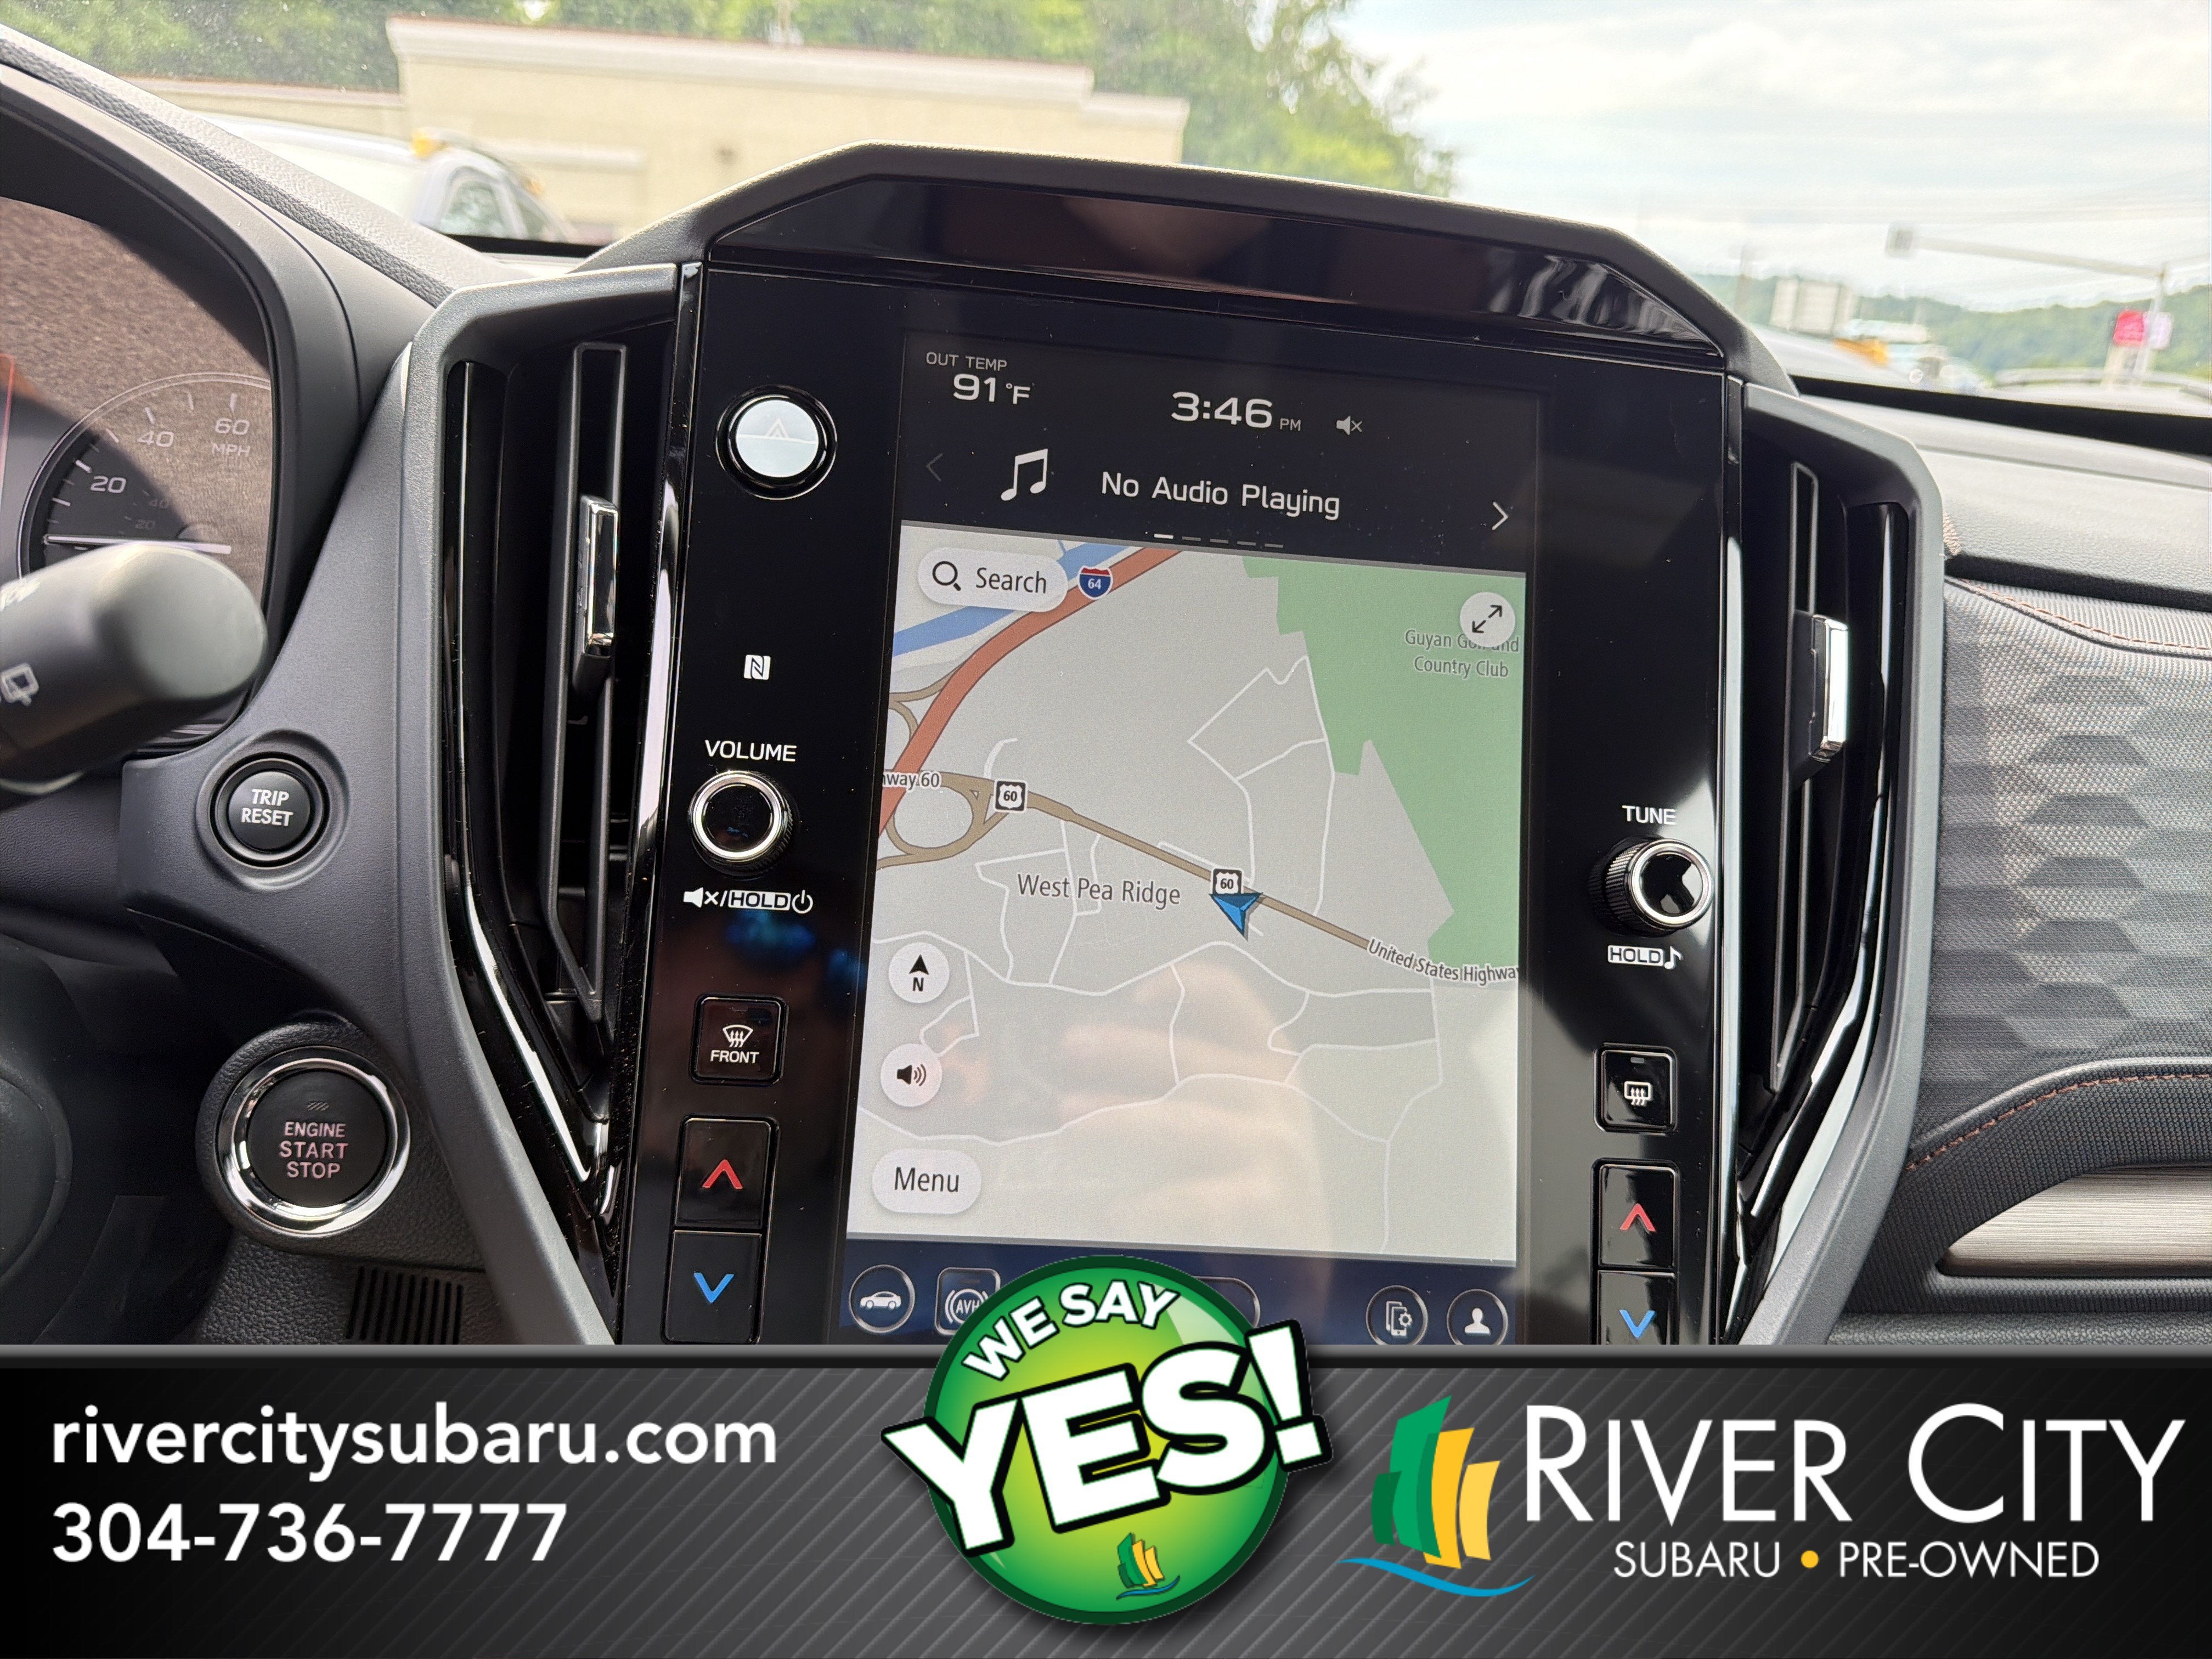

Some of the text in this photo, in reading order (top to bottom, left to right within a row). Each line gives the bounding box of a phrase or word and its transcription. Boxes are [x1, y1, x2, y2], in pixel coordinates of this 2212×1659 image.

[926, 352, 1007, 371] OUT TEMP
[953, 373, 996, 402] 91
[1171, 392, 1301, 431] 3:46 PM
[215, 418, 250, 435] 60
[138, 430, 174, 447] 40
[212, 442, 250, 456] MPH
[91, 476, 126, 494] 20
[1102, 471, 1340, 521] No Audio Playing
[975, 567, 1047, 594] Search
[1088, 579, 1102, 590] 64
[1405, 630, 1451, 650] Guyan
[1414, 656, 1508, 679] Country Club
[705, 740, 797, 762] VOLUME
[922, 772, 940, 788] 60
[251, 789, 289, 806] TRIP
[1003, 790, 1017, 802] 60
[241, 808, 294, 826] RESET
[1622, 805, 1676, 825] TUNE
[1018, 874, 1181, 910] West Pea Ridge
[1221, 878, 1234, 889] 60
[1369, 939, 1414, 968] United
[1417, 958, 1458, 980] States
[1609, 947, 1662, 963] HOLD
[912, 977, 924, 992] N
[710, 1050, 759, 1064] FRONT
[284, 1121, 346, 1138] ENGINE
[280, 1141, 348, 1159] START
[287, 1161, 341, 1178] STOP
[894, 1167, 959, 1193] Menu
